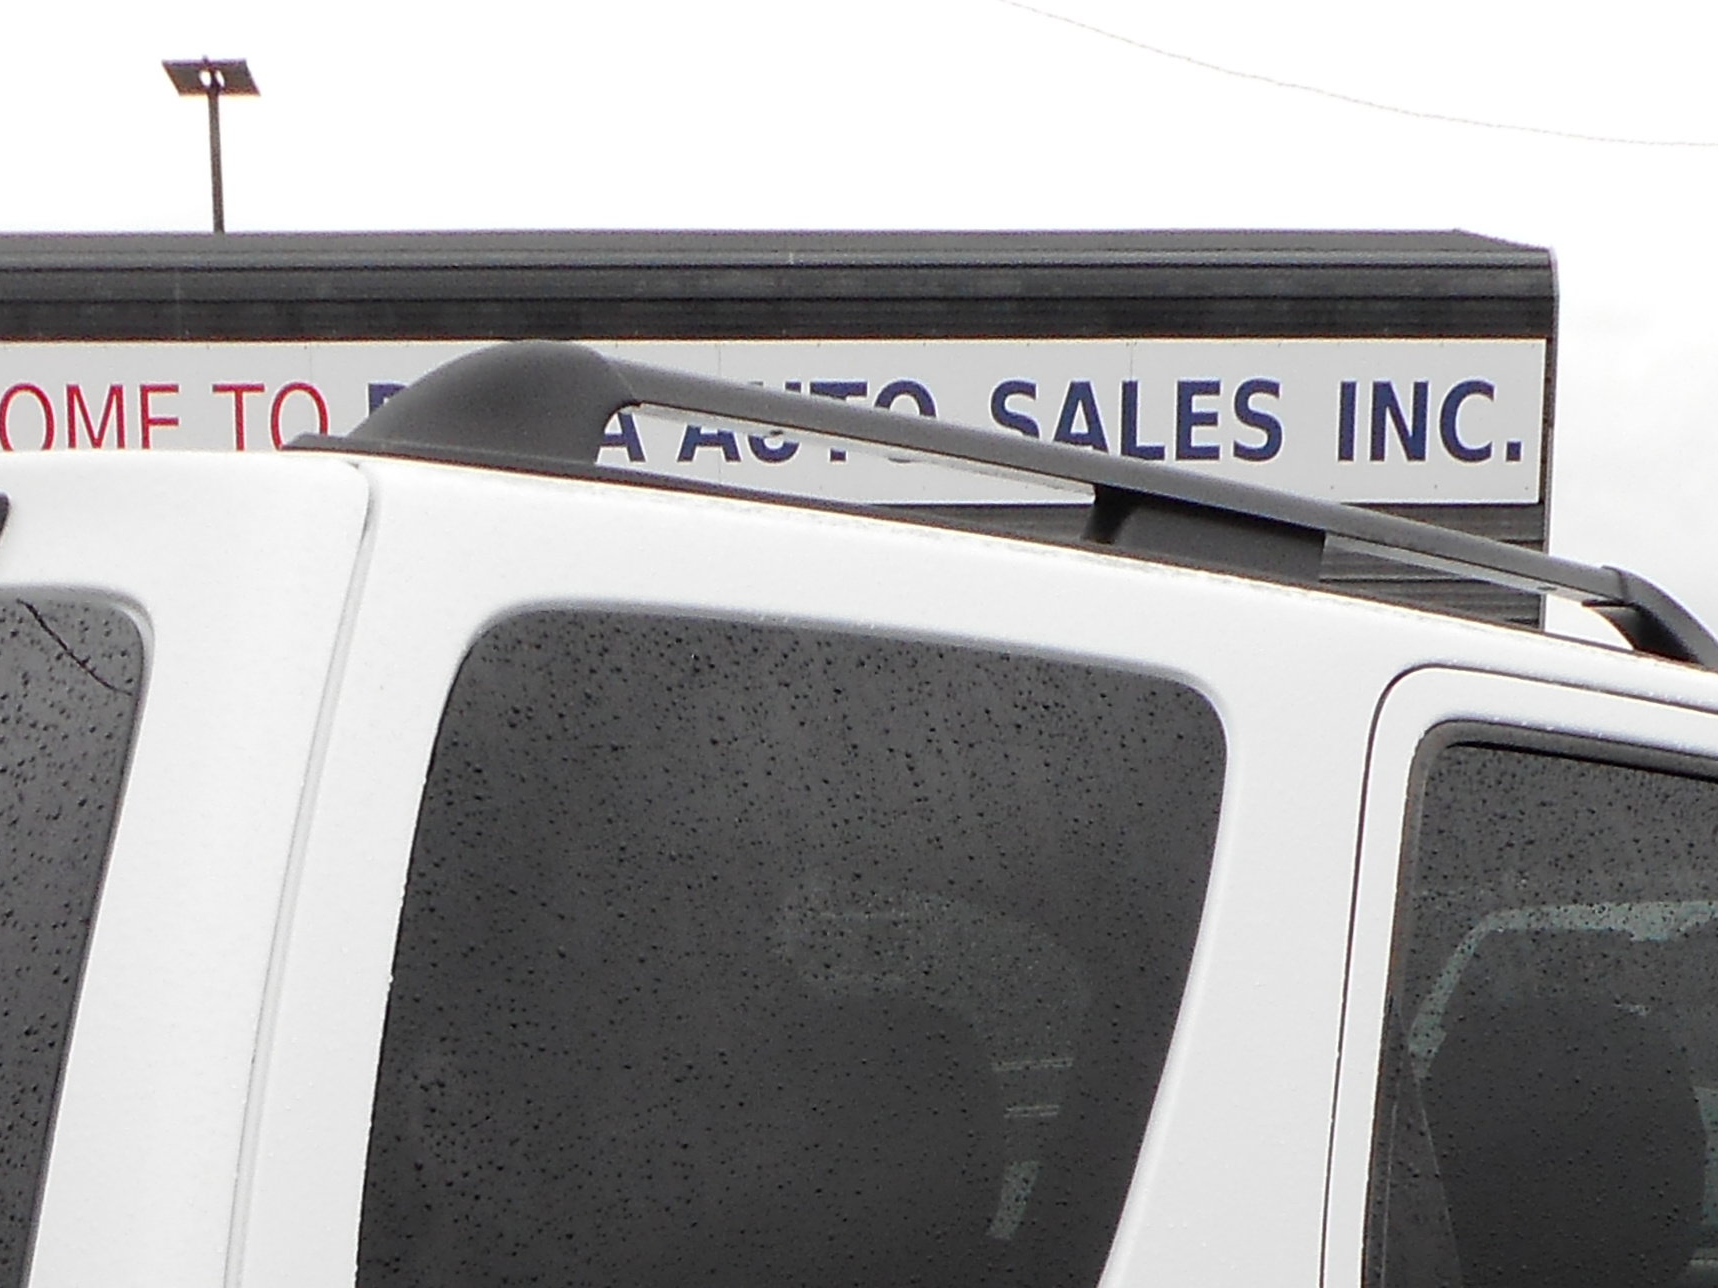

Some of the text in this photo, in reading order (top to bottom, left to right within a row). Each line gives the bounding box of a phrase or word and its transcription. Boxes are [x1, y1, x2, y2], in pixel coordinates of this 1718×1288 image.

[212, 382, 330, 452] TO
[989, 379, 1284, 462] SALES
[1337, 379, 1523, 463] INC.
